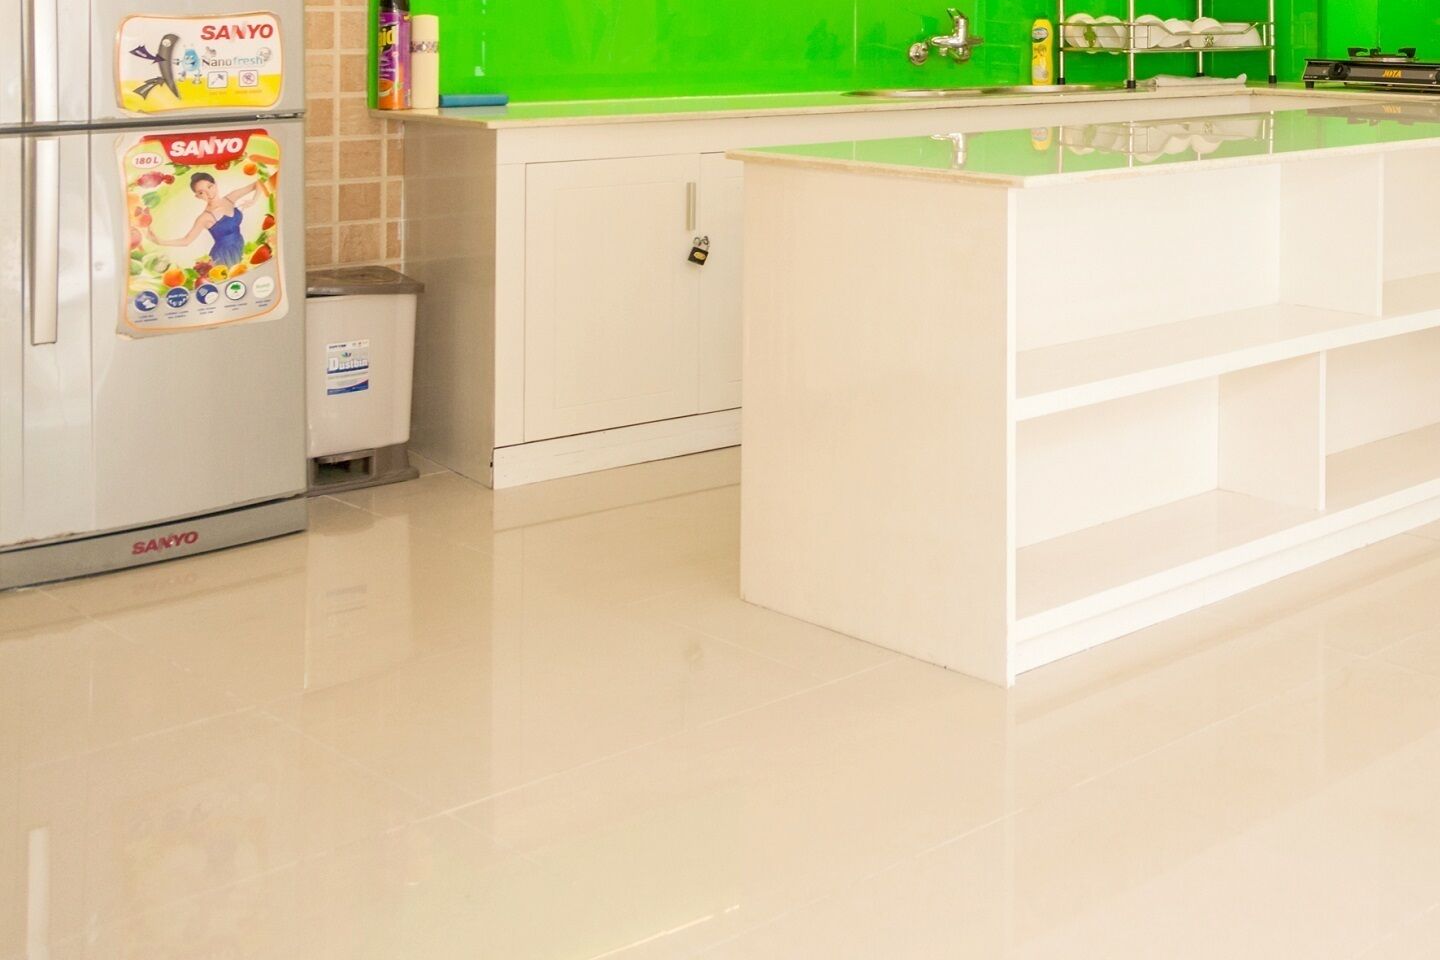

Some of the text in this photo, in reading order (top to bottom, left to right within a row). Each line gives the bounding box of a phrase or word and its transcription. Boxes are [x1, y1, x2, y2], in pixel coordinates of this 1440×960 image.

[200, 23, 274, 41] SANYO
[378, 24, 396, 45] aid
[1382, 69, 1403, 78] JOTA
[169, 136, 244, 158] SANYO
[329, 357, 368, 371] Dustbin
[131, 530, 199, 555] SANYO
